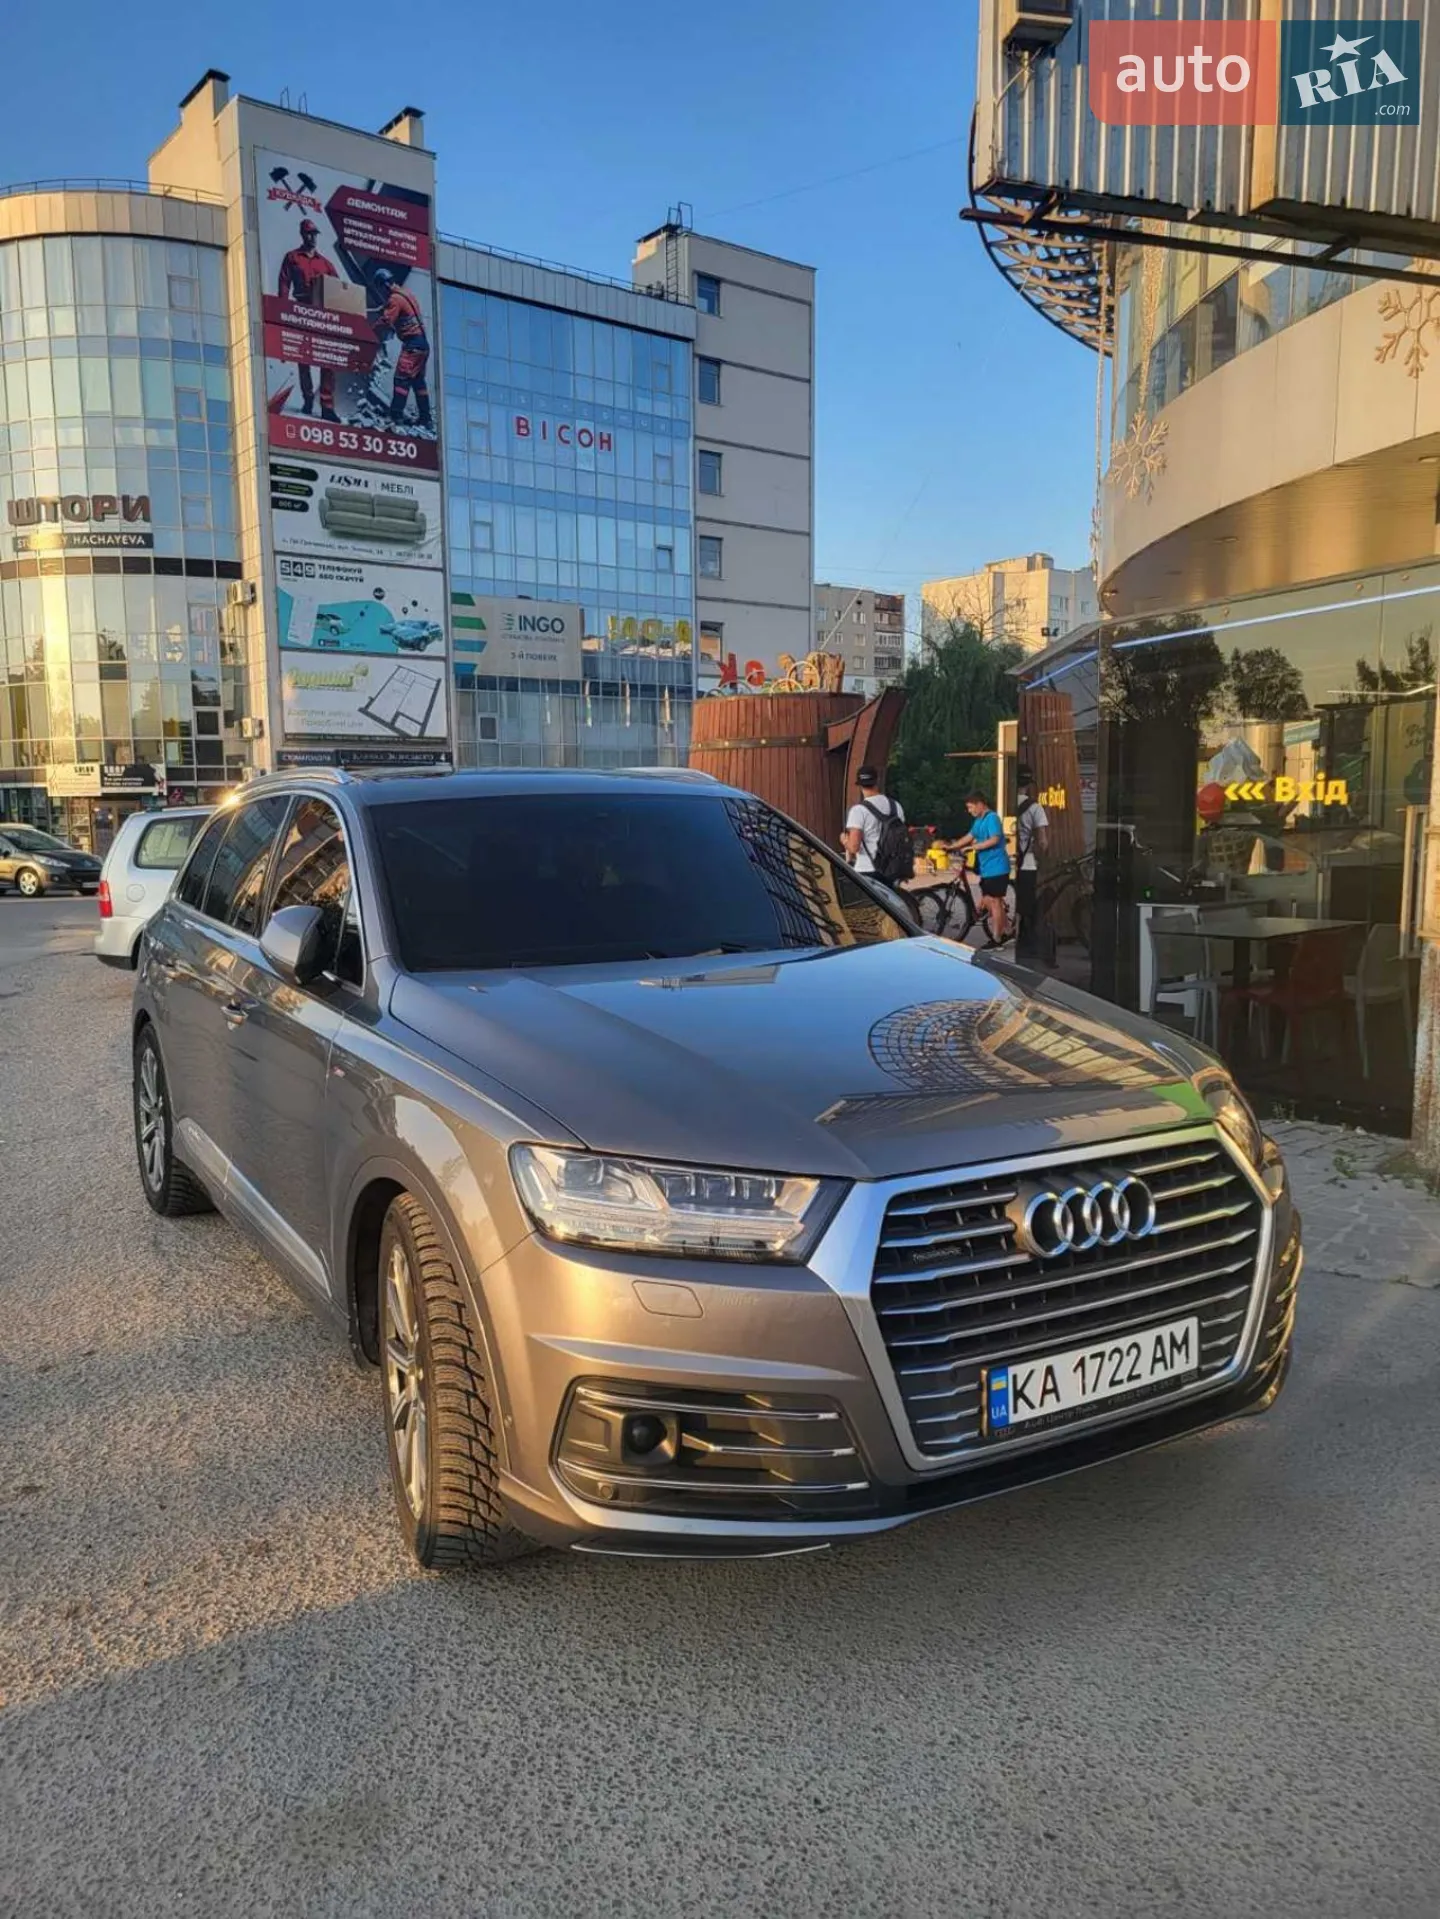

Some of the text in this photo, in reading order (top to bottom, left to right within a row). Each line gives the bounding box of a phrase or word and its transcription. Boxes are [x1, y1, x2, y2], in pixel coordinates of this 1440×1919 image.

[346, 197, 408, 219] ДЕМОНТАЖ
[293, 305, 340, 321] ПОСЛУГИ
[281, 313, 353, 335] ВАНТАЖНИКІВ
[300, 426, 417, 459] 098 53 30 330
[381, 482, 414, 496] МЕБЛІ
[7, 495, 152, 526] ШТОРИ
[73, 535, 145, 546] HACHAYEVA
[280, 560, 315, 578] 549
[519, 615, 565, 634] INGO
[1275, 773, 1347, 806] Вхід
[1012, 1364, 1060, 1414] KA
[1073, 1342, 1141, 1396] 1722
[1150, 1326, 1190, 1375] AM
[991, 1405, 1008, 1419] UA
